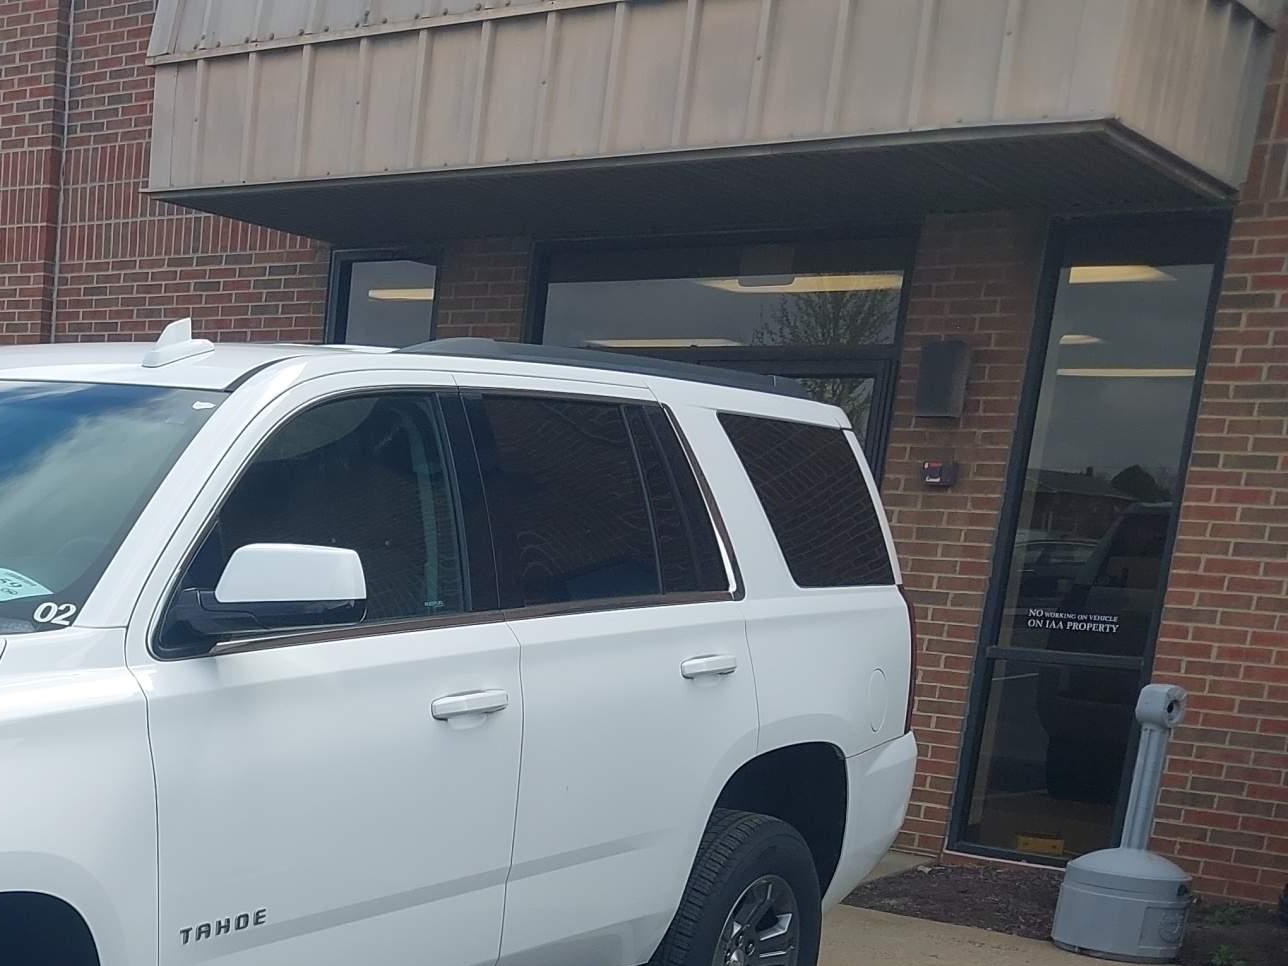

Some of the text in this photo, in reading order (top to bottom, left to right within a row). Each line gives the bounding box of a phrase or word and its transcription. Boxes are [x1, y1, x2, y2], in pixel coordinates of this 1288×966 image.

[33, 602, 76, 625] 02
[1028, 608, 1043, 617] NO
[1045, 612, 1076, 620] WORKING
[1089, 615, 1118, 623] VEHICLE
[1027, 619, 1119, 633] ON IAA PROPERTY
[179, 908, 266, 945] TAHOE
